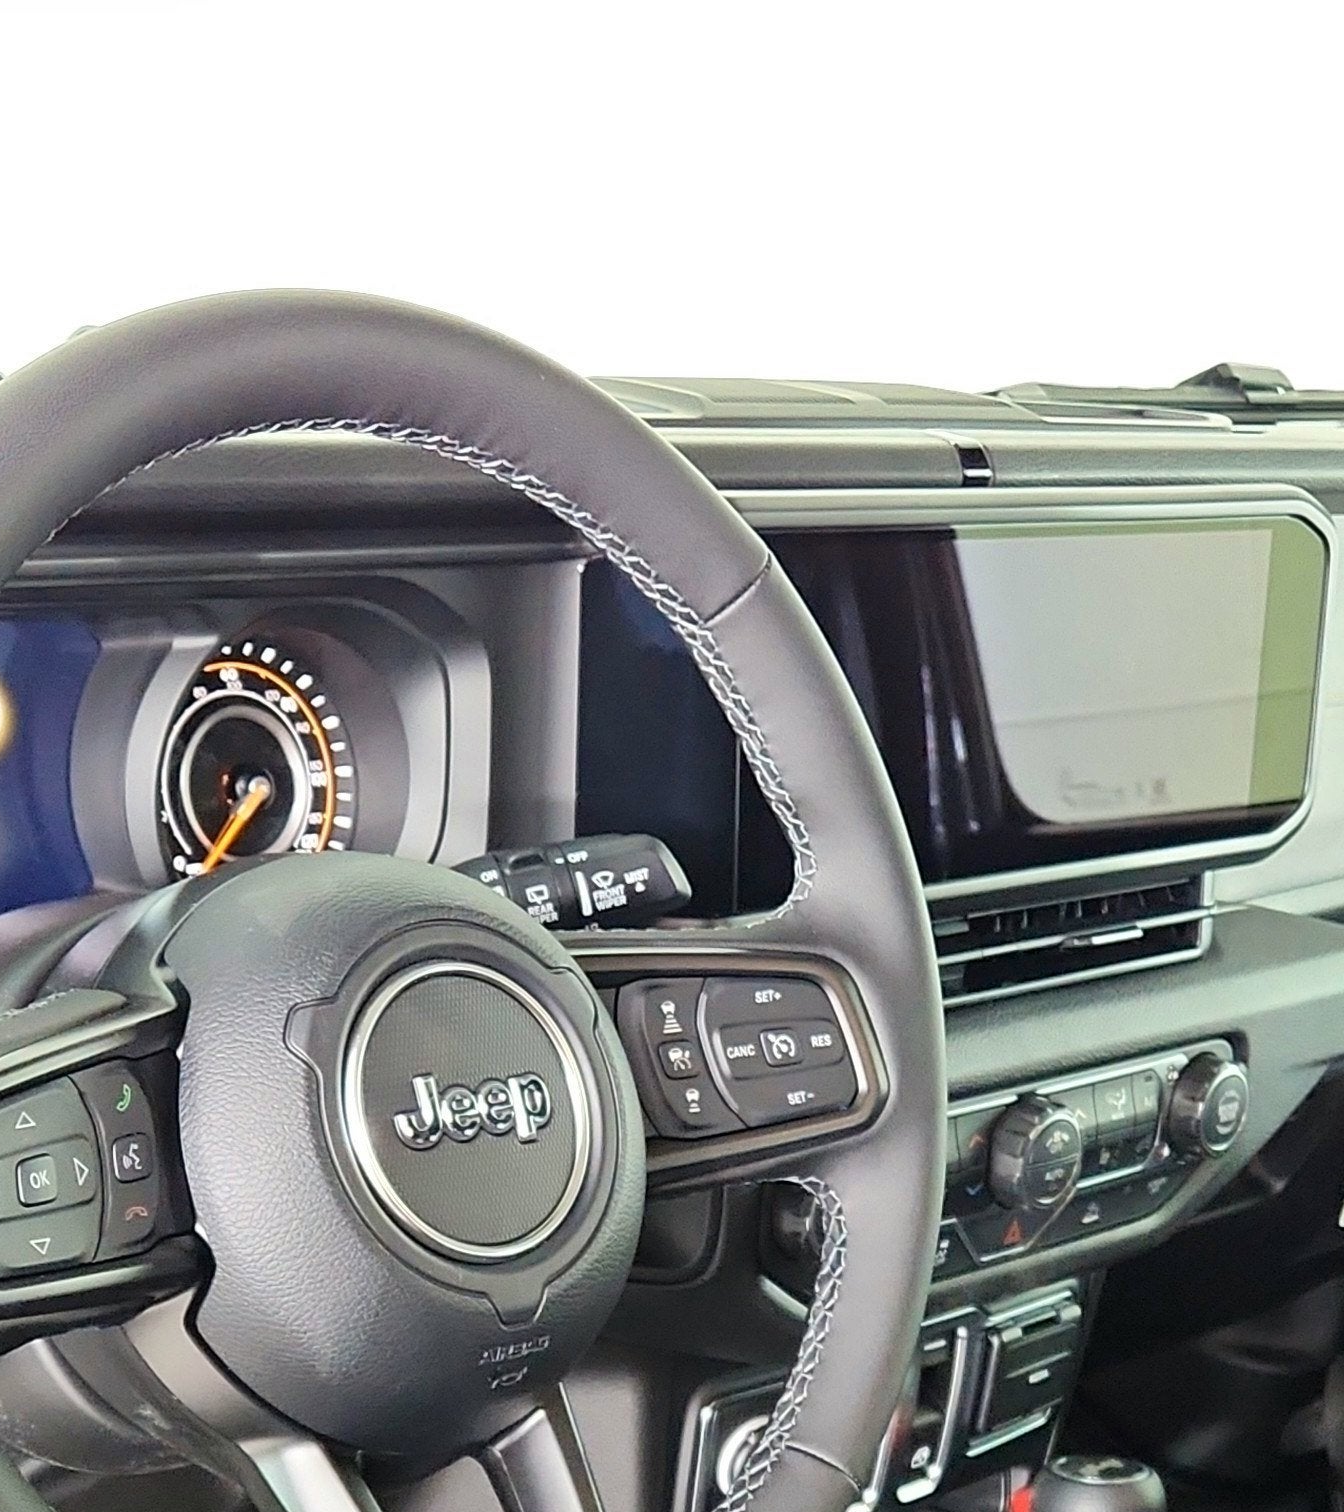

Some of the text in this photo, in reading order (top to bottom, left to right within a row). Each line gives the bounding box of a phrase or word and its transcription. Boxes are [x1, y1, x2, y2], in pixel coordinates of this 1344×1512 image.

[567, 850, 589, 864] OFF
[592, 883, 625, 900] FRONT
[527, 902, 556, 916] REAR
[594, 895, 628, 912] WIPER
[810, 1034, 833, 1048] RES
[726, 1044, 756, 1060] CANC
[392, 1073, 552, 1151] Jeep
[29, 1169, 52, 1189] OK
